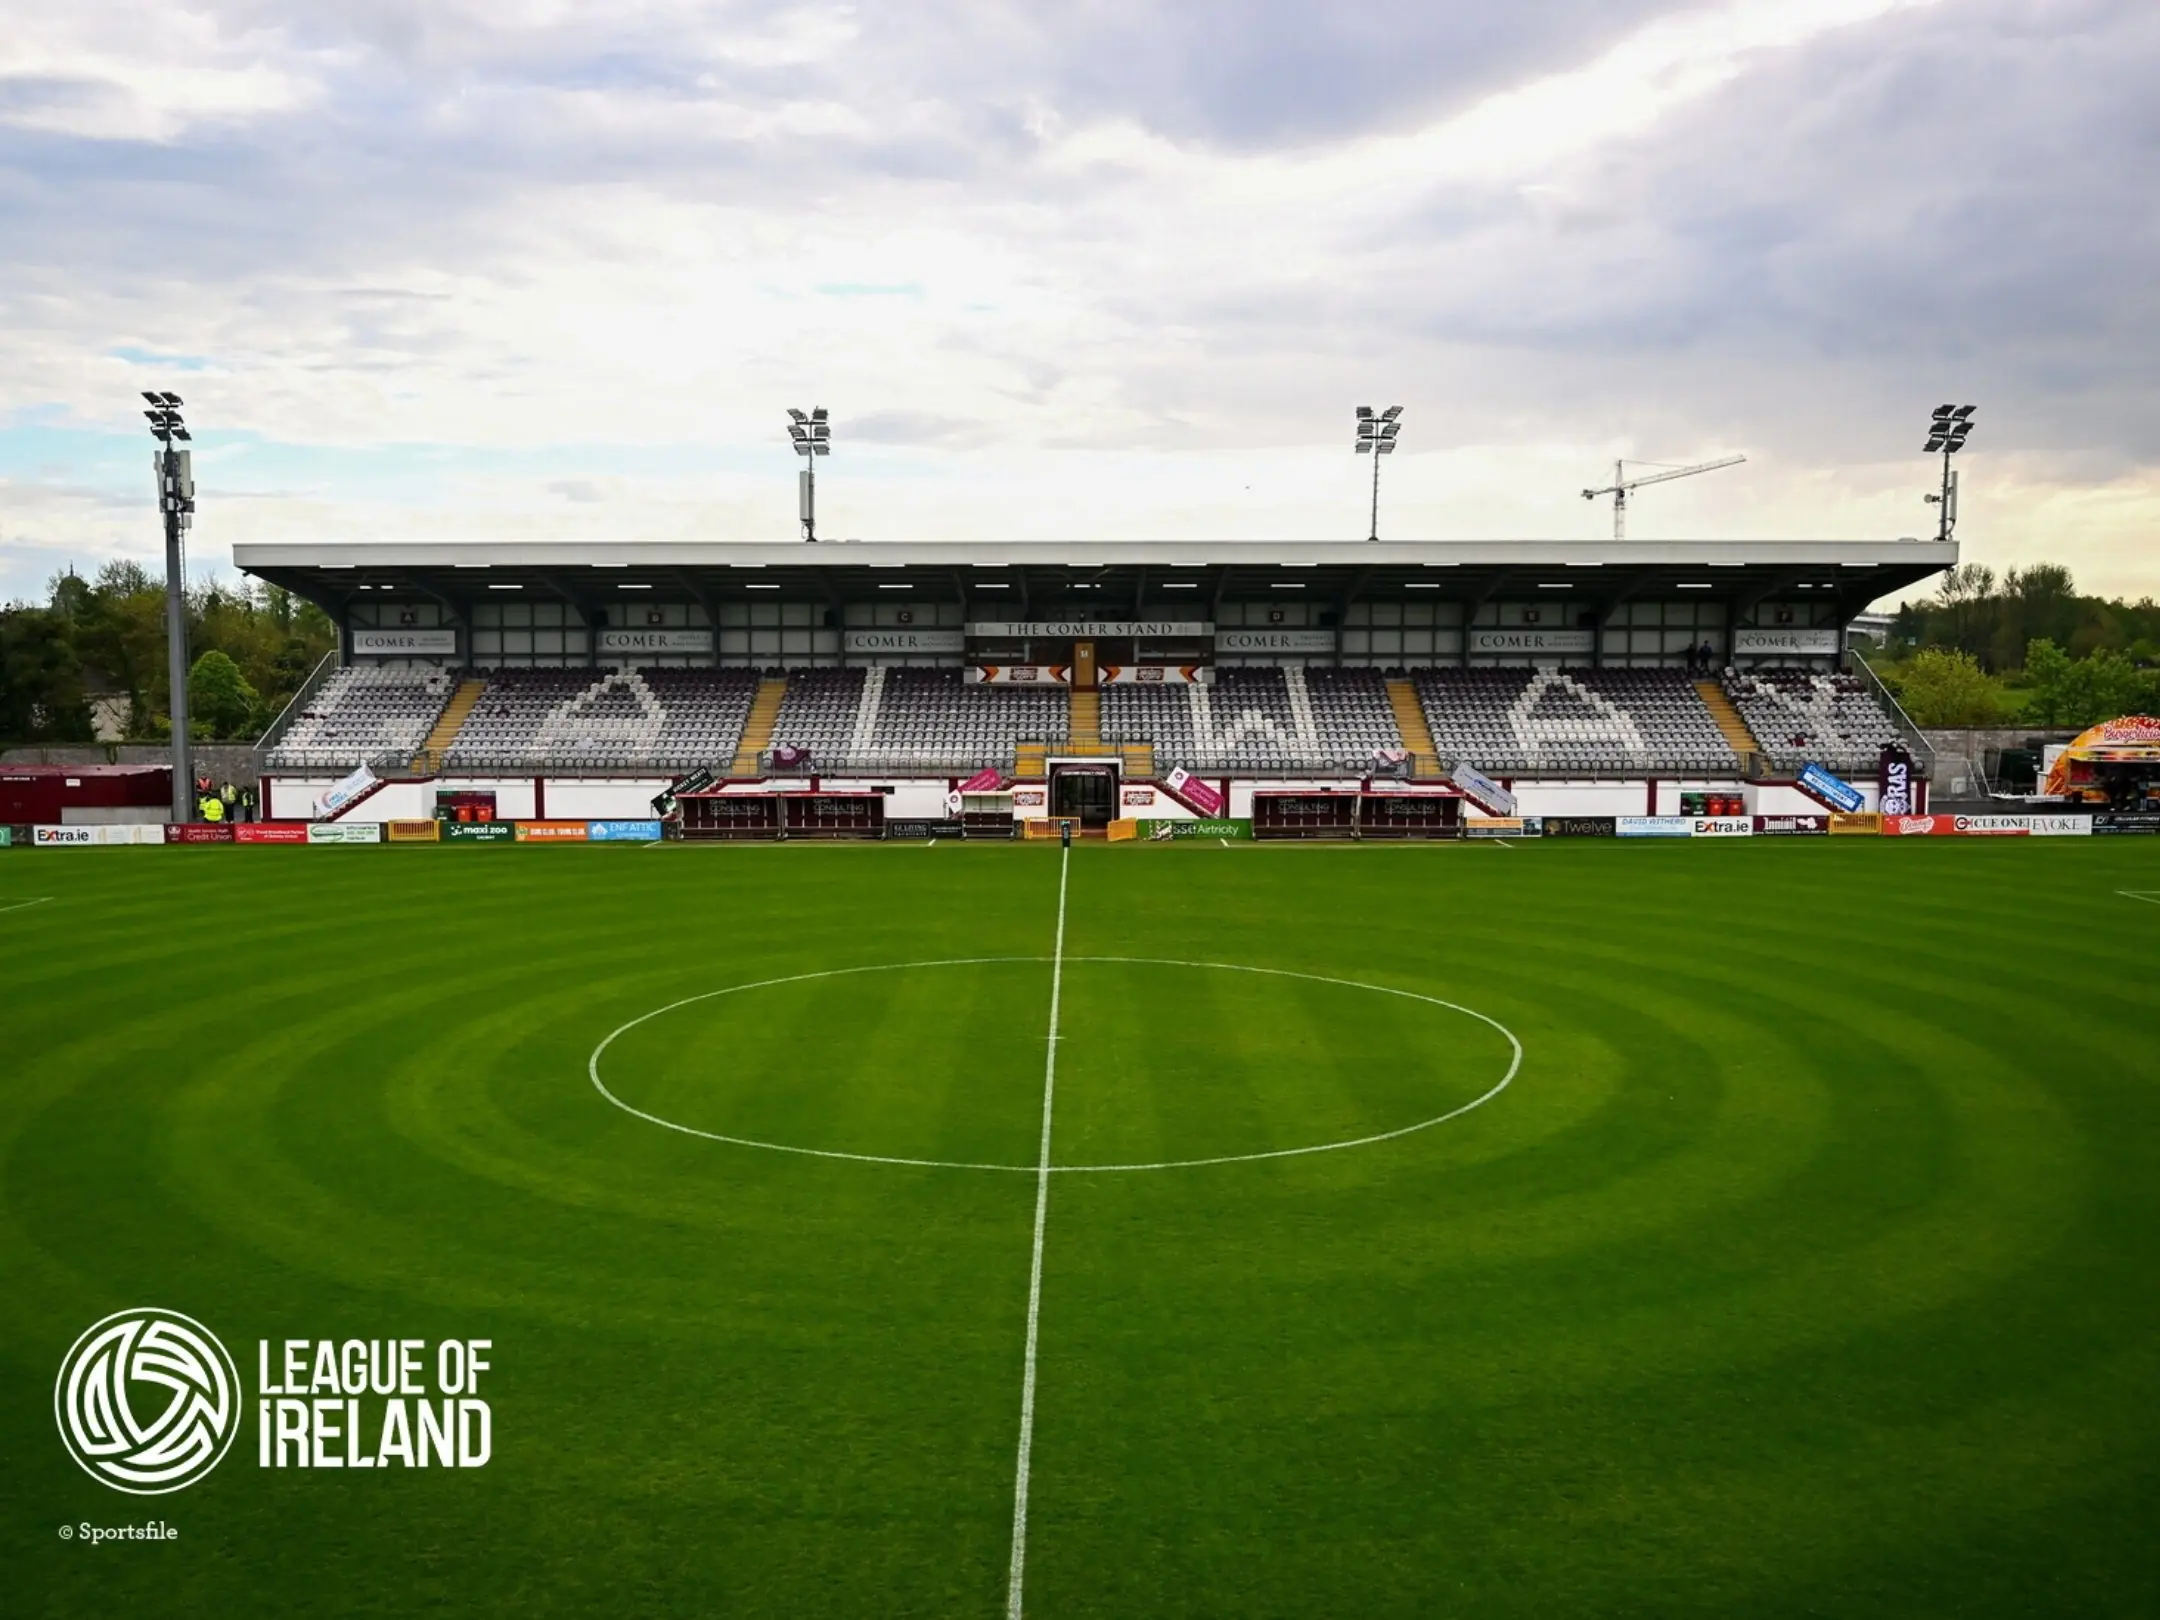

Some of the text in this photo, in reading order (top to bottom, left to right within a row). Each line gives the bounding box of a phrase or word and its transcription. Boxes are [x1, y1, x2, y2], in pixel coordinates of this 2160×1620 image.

[1006, 623, 1173, 635] THE COMER STAND
[365, 636, 415, 647] COMER
[605, 634, 668, 647] COMER
[855, 635, 918, 647] COMER
[1226, 634, 1290, 647] COMER
[1480, 635, 1544, 647] COMER
[1745, 636, 1799, 648] COMER
[463, 824, 488, 834] maxi
[1197, 824, 1239, 836] Airtricity
[1563, 820, 1612, 833] Twelve
[1695, 820, 1749, 833] Extra.ie
[2033, 818, 2080, 831] EVOKE
[37, 829, 89, 842] Extra.ie
